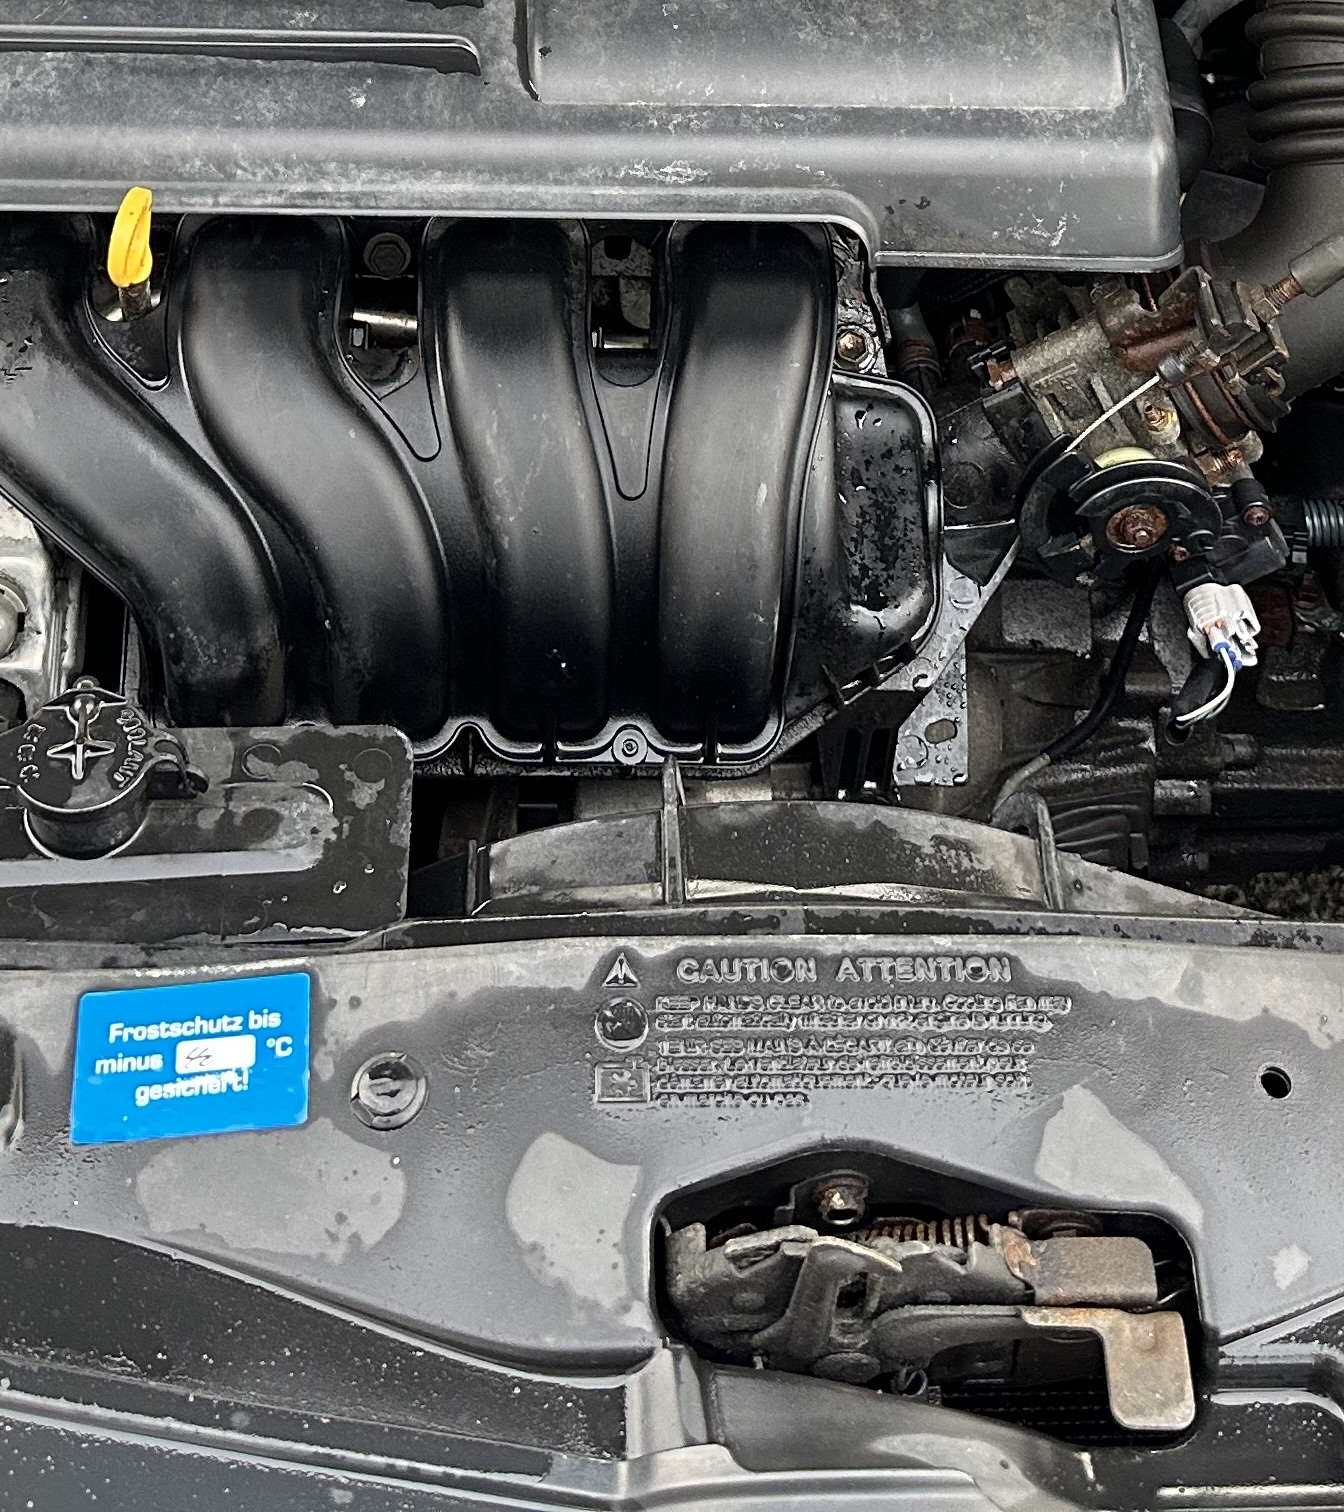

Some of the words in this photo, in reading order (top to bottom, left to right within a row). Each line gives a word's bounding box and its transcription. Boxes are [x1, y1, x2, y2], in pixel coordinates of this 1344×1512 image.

[677, 956, 818, 984] CAUTION
[835, 956, 1012, 983] ATTENTION
[109, 1016, 243, 1044] Frostschutz
[248, 1008, 281, 1030] bis
[95, 1052, 163, 1074] minus
[135, 1067, 249, 1107] gesichert!
